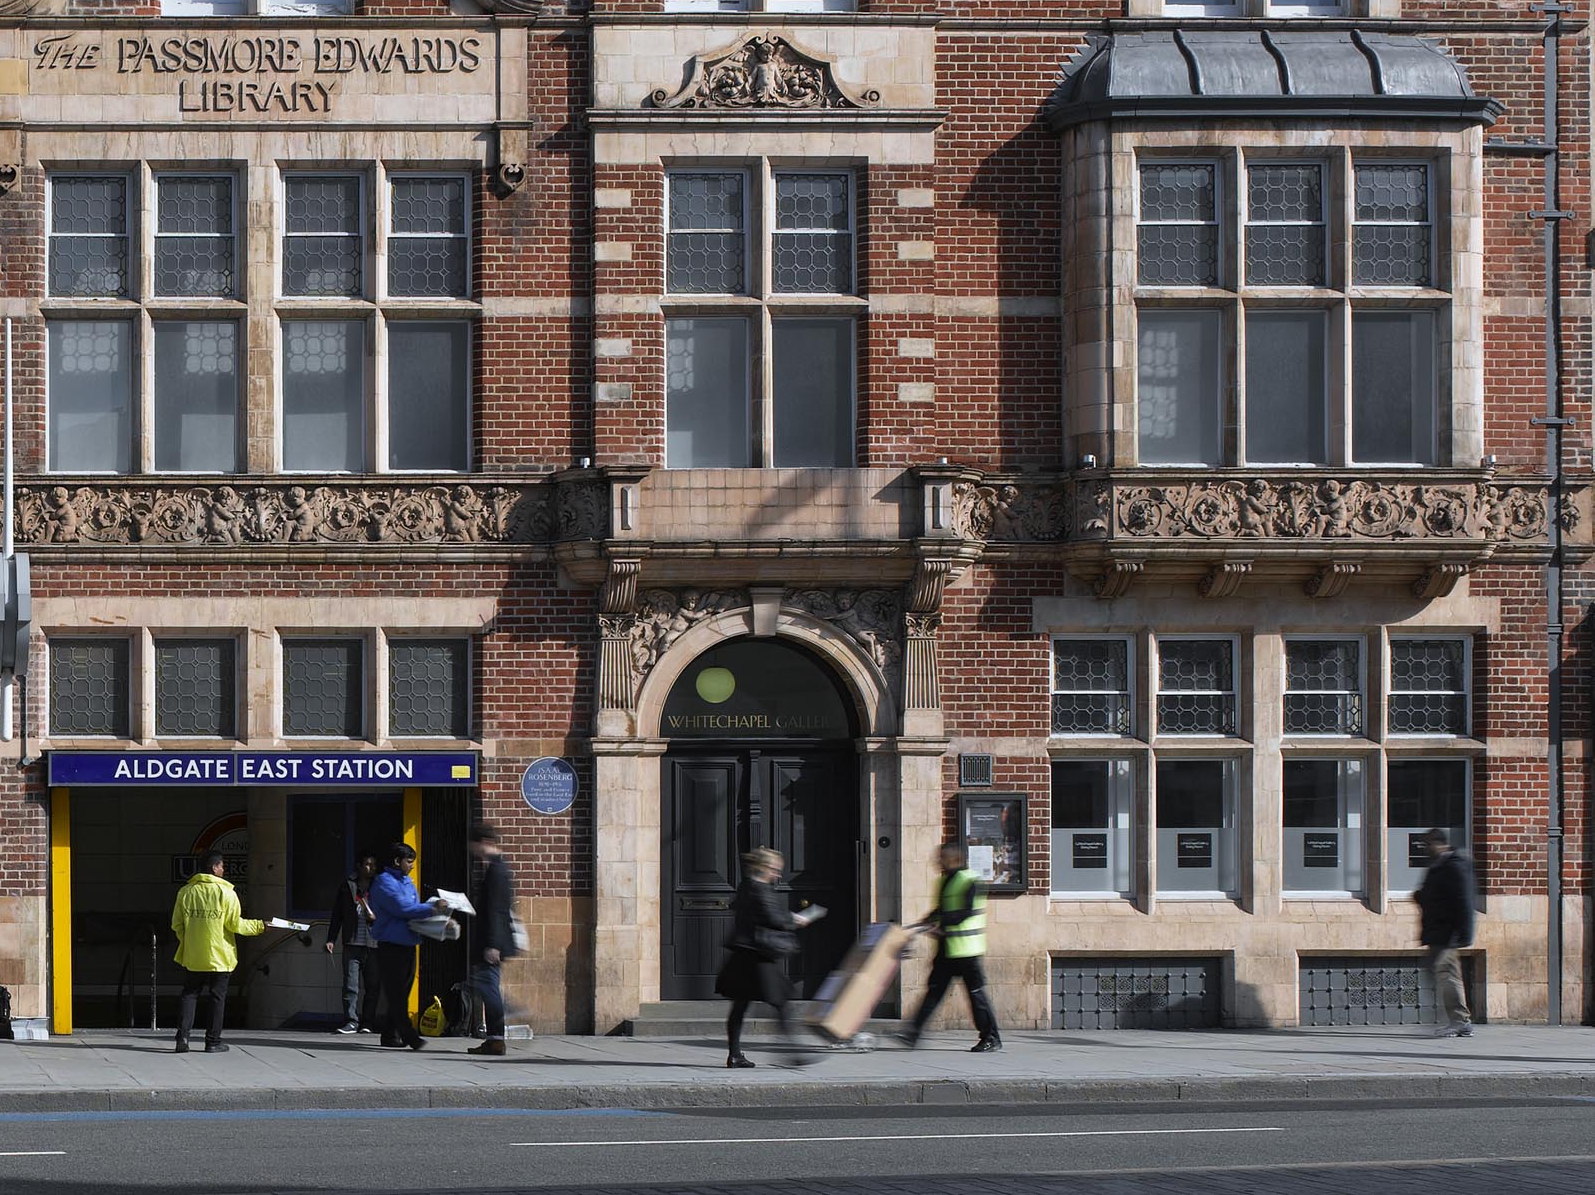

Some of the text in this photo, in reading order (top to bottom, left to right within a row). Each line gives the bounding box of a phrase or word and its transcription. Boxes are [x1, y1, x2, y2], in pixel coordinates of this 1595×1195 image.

[117, 36, 303, 74] PASSMORE
[314, 36, 482, 74] EDWARDS
[178, 80, 337, 113] LIBRARY
[668, 715, 831, 729] WHITECHAPEL GALLER
[113, 759, 414, 779] ALDGATE EAST STATION
[528, 773, 572, 781] ROSENBERG
